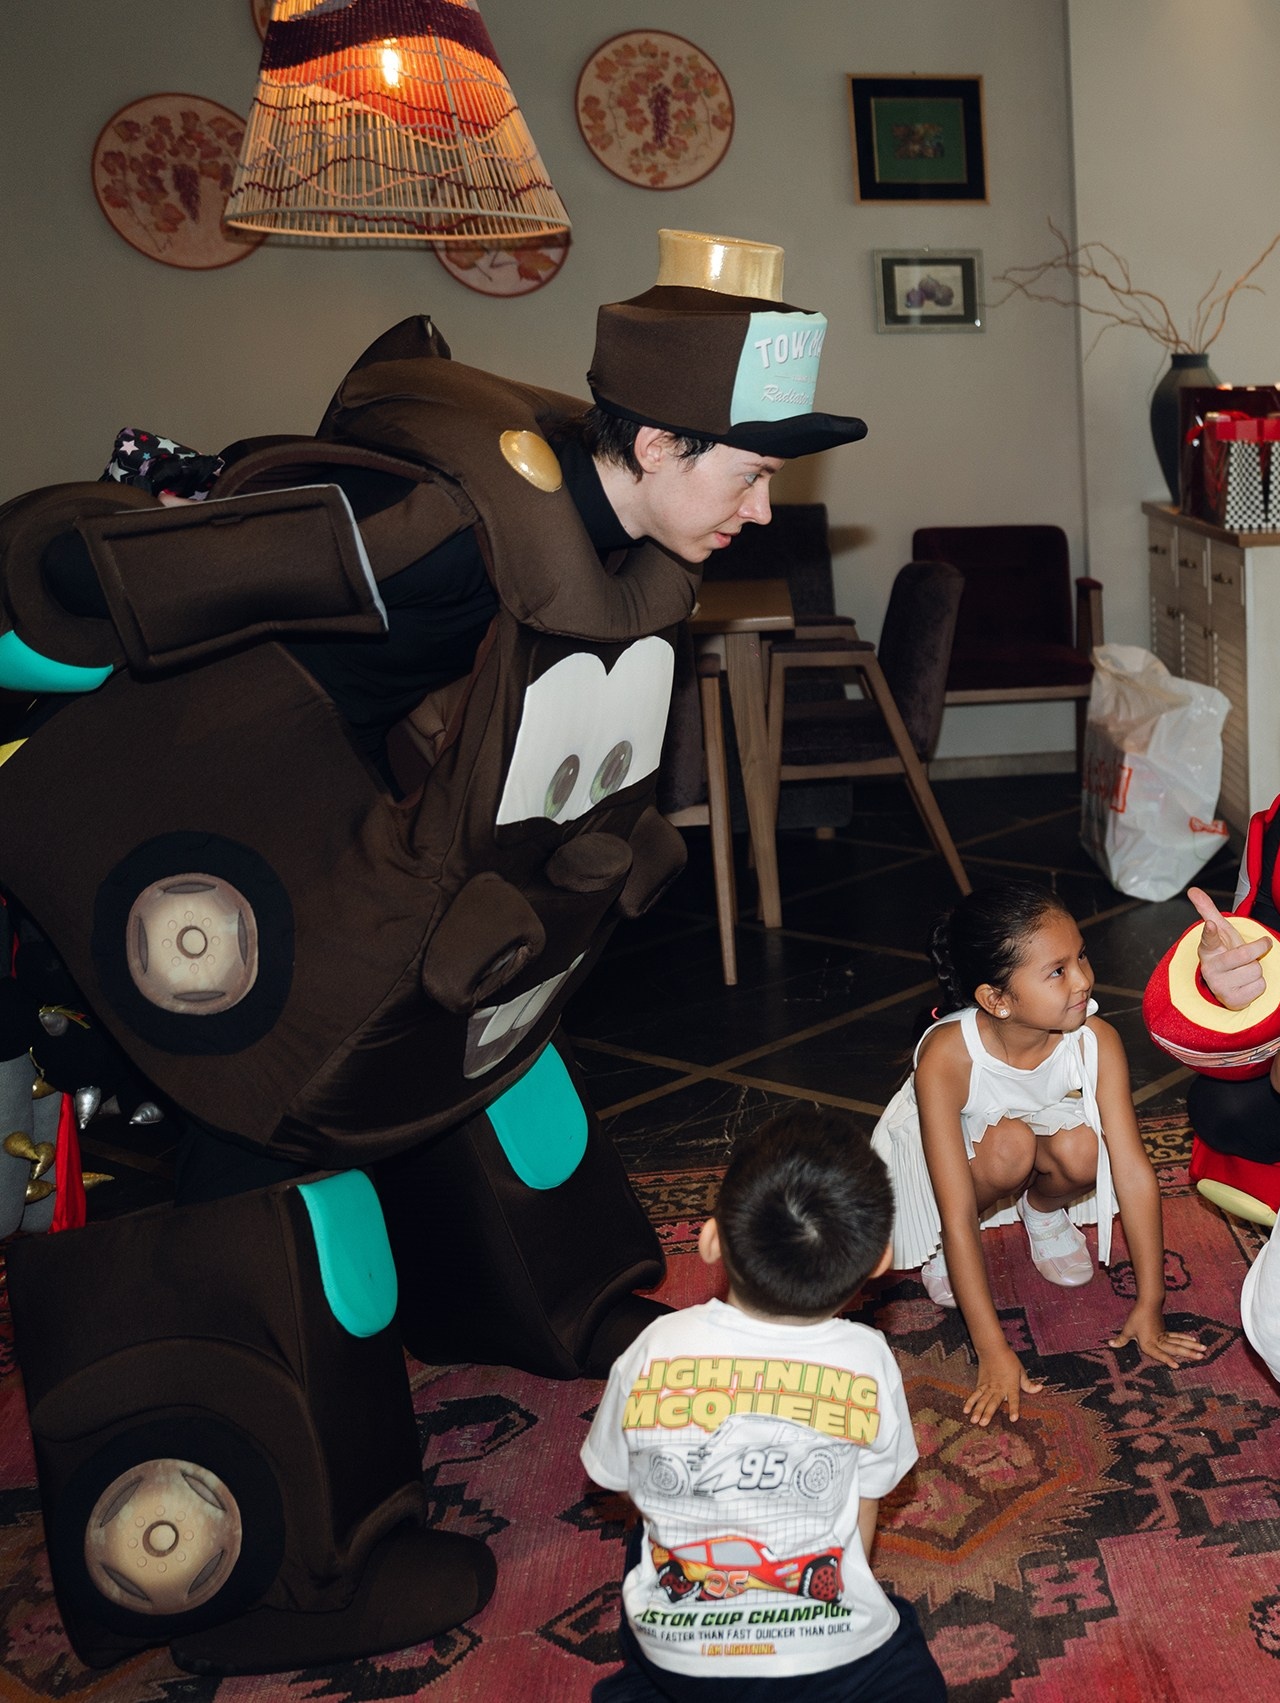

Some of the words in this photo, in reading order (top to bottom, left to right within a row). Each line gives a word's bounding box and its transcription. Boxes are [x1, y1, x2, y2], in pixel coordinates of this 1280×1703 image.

[754, 330, 811, 369] TOW
[737, 1450, 788, 1490] 95
[634, 1608, 698, 1627] ISTON
[701, 1611, 743, 1626] CUP
[747, 1602, 853, 1624] CHAMPION
[661, 1630, 695, 1641] FASTER
[699, 1629, 723, 1640] THAN
[755, 1627, 796, 1640] QUICKER
[800, 1625, 824, 1637] THAN
